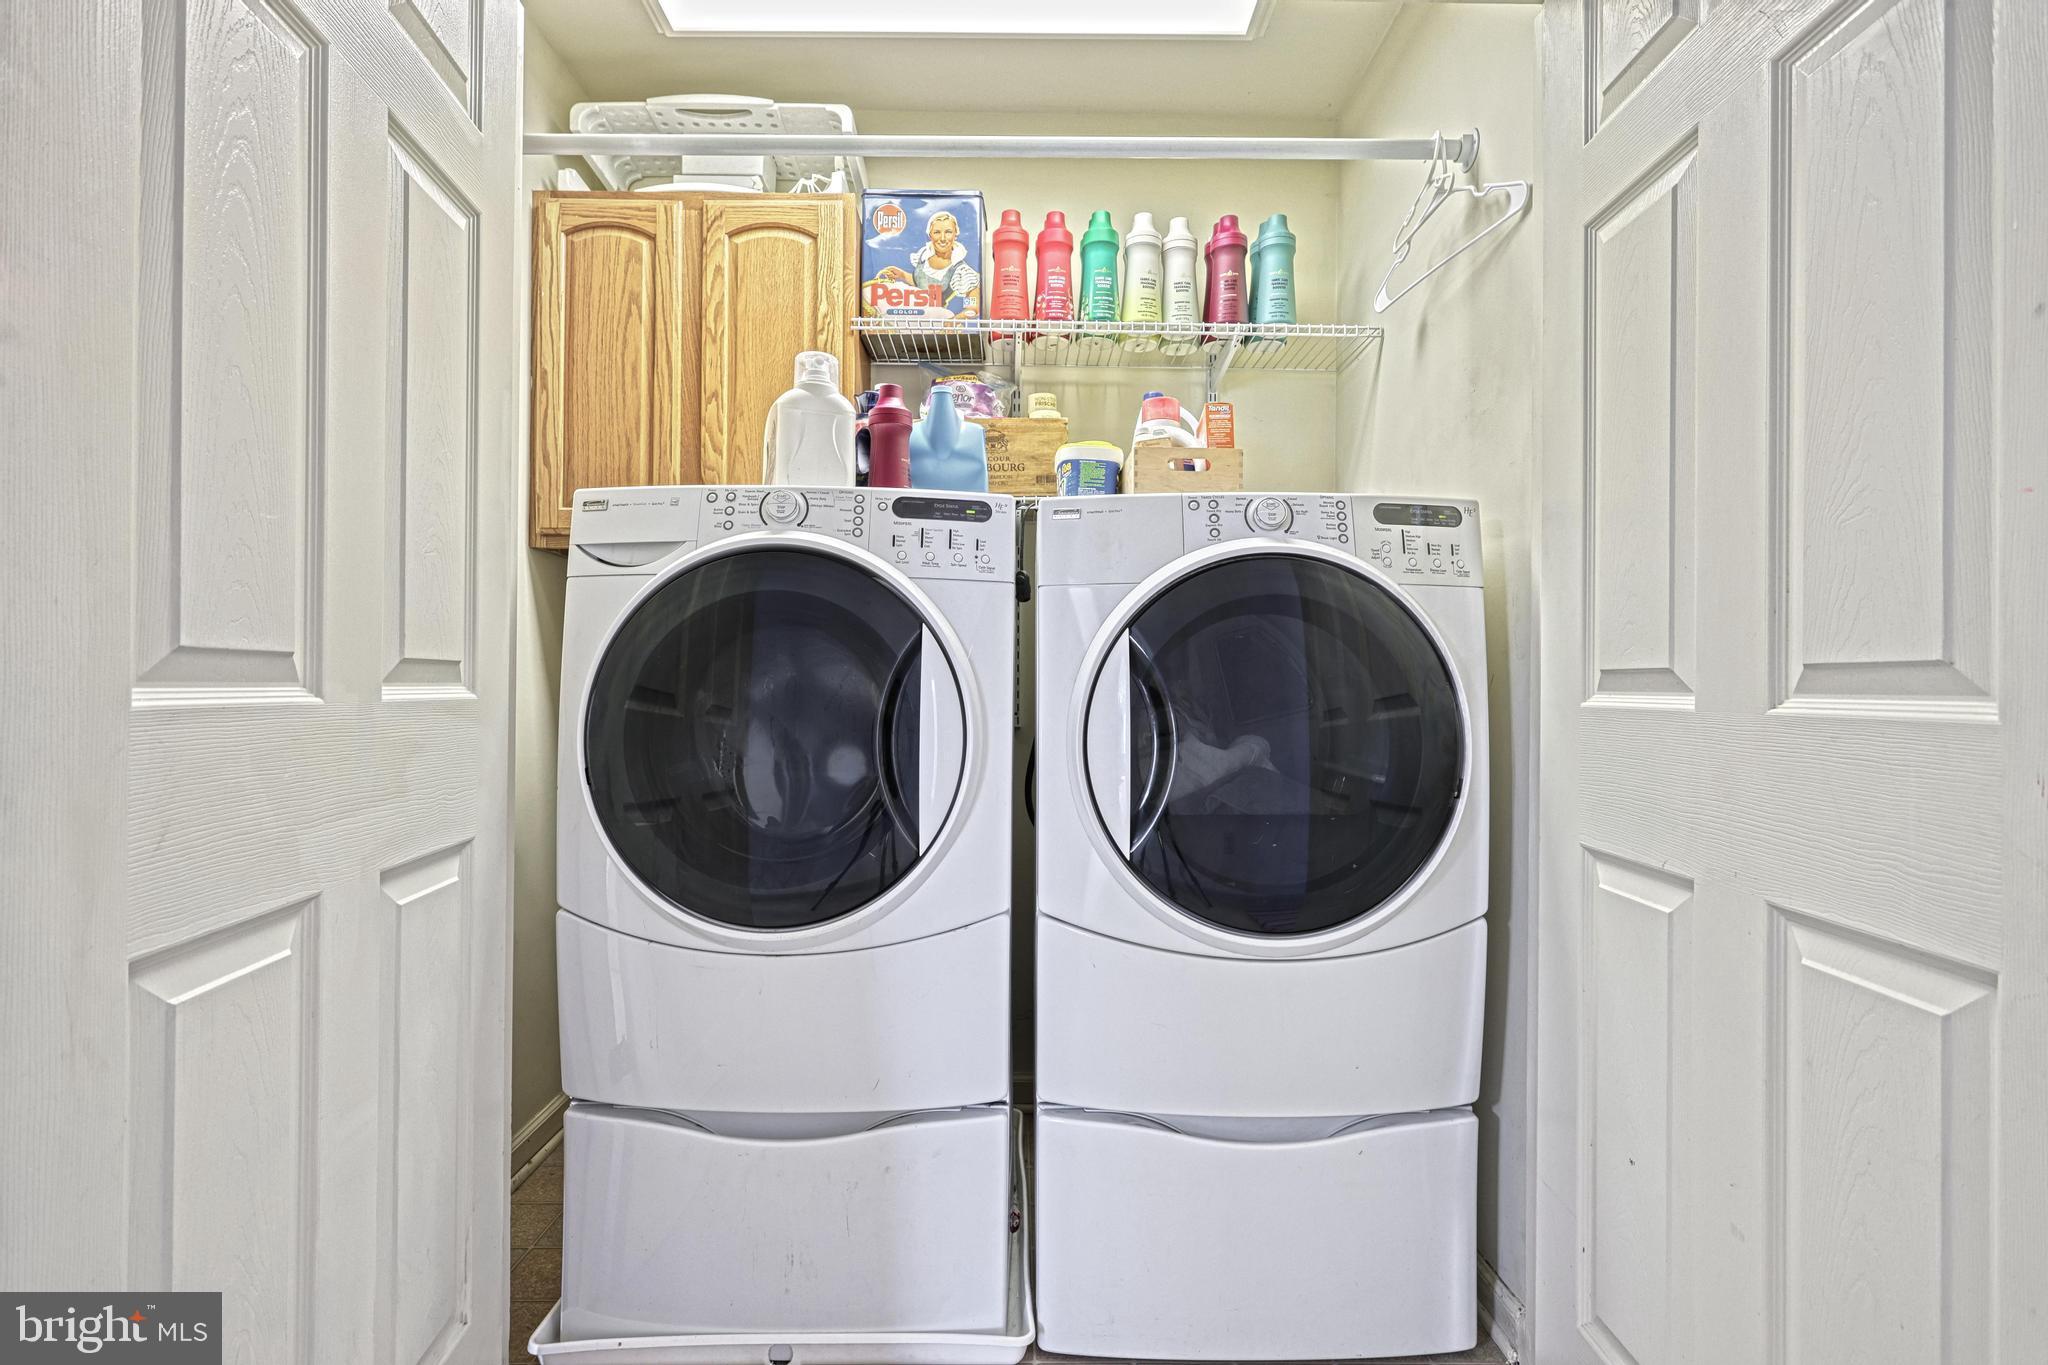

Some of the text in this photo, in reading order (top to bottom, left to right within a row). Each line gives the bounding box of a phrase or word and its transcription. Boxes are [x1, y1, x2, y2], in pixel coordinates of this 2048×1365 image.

[877, 211, 903, 230] Persil
[870, 284, 944, 307] Persil
[951, 393, 974, 403] enor
[986, 462, 1025, 472] BOURG
